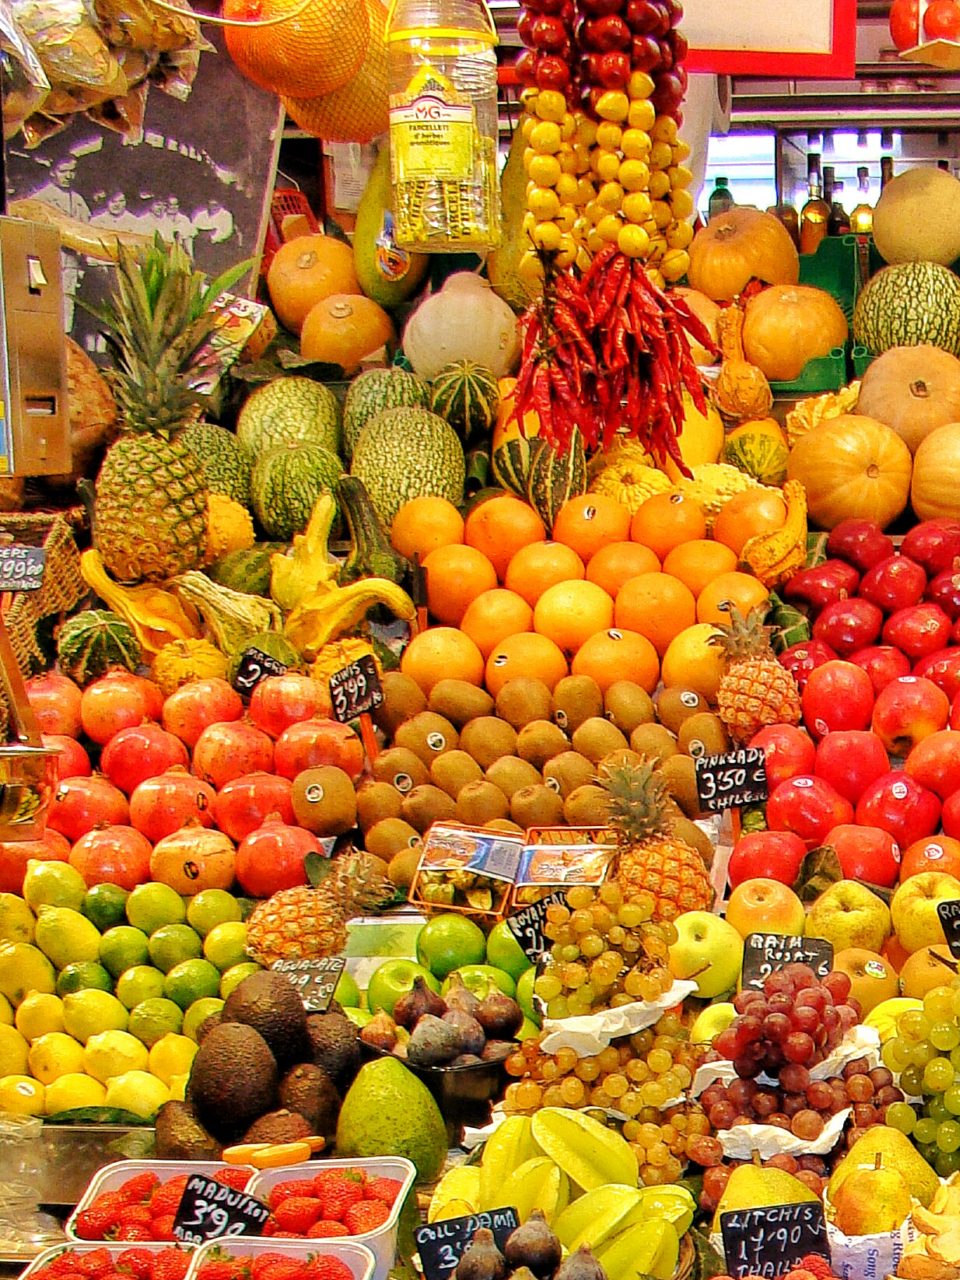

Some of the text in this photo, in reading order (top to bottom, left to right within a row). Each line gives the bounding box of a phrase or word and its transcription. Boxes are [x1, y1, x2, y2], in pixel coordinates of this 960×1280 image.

[330, 661, 360, 688] KIWIS
[700, 768, 746, 799] 3'50
[187, 1177, 271, 1222] MADUIXOT
[182, 1199, 246, 1239] 3'90
[728, 1206, 814, 1229] LITCHIS
